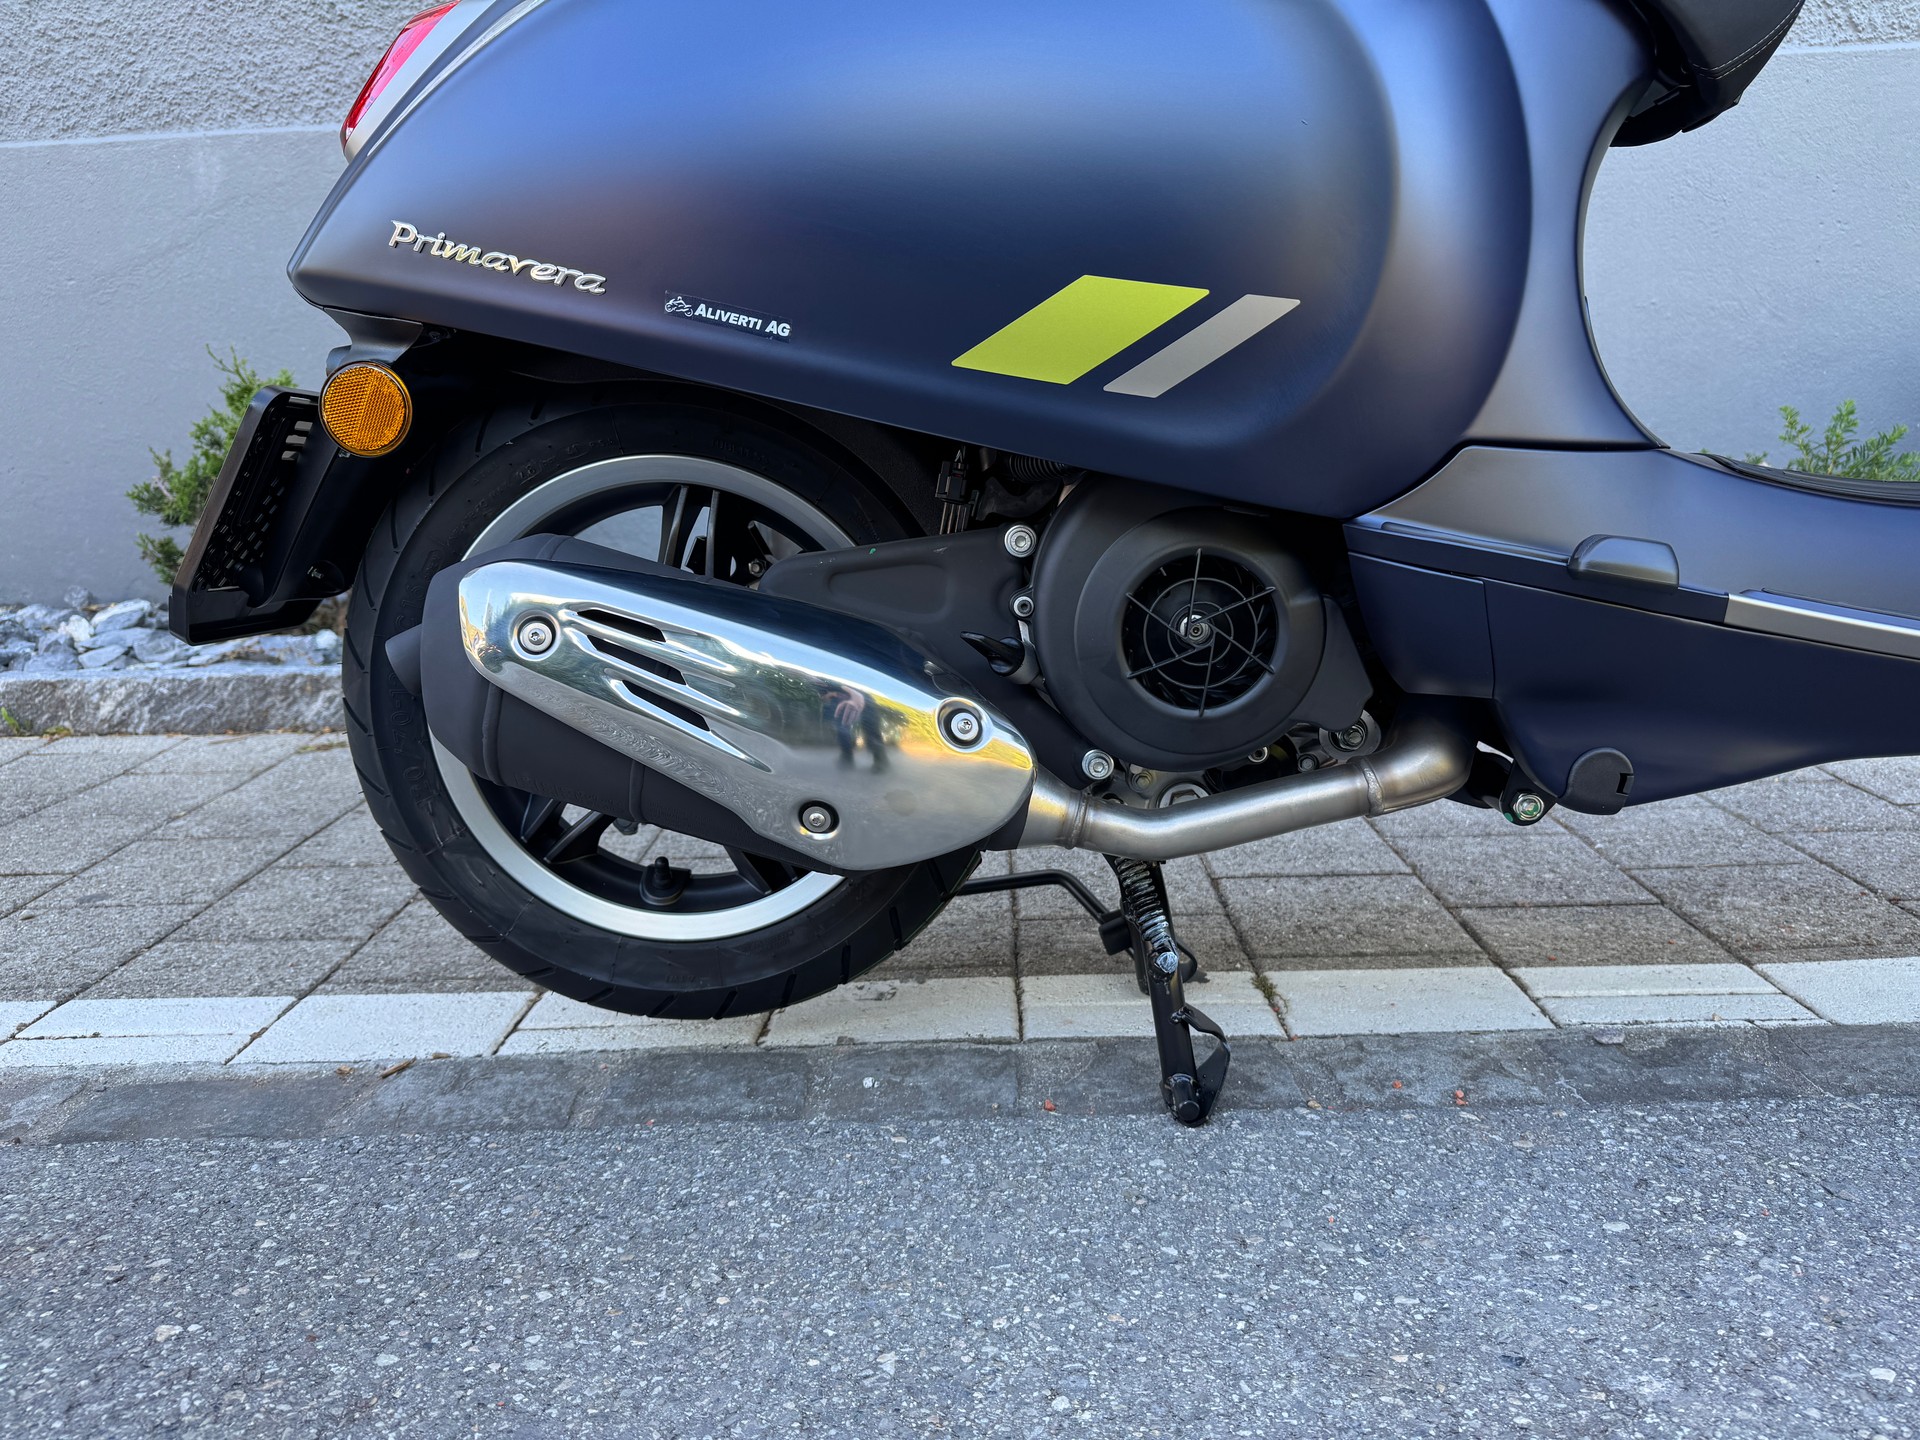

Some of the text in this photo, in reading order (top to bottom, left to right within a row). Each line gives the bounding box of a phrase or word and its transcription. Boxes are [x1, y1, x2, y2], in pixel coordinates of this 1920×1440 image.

[389, 219, 607, 295] Primavera
[694, 303, 791, 337] ALIVERTI AG
